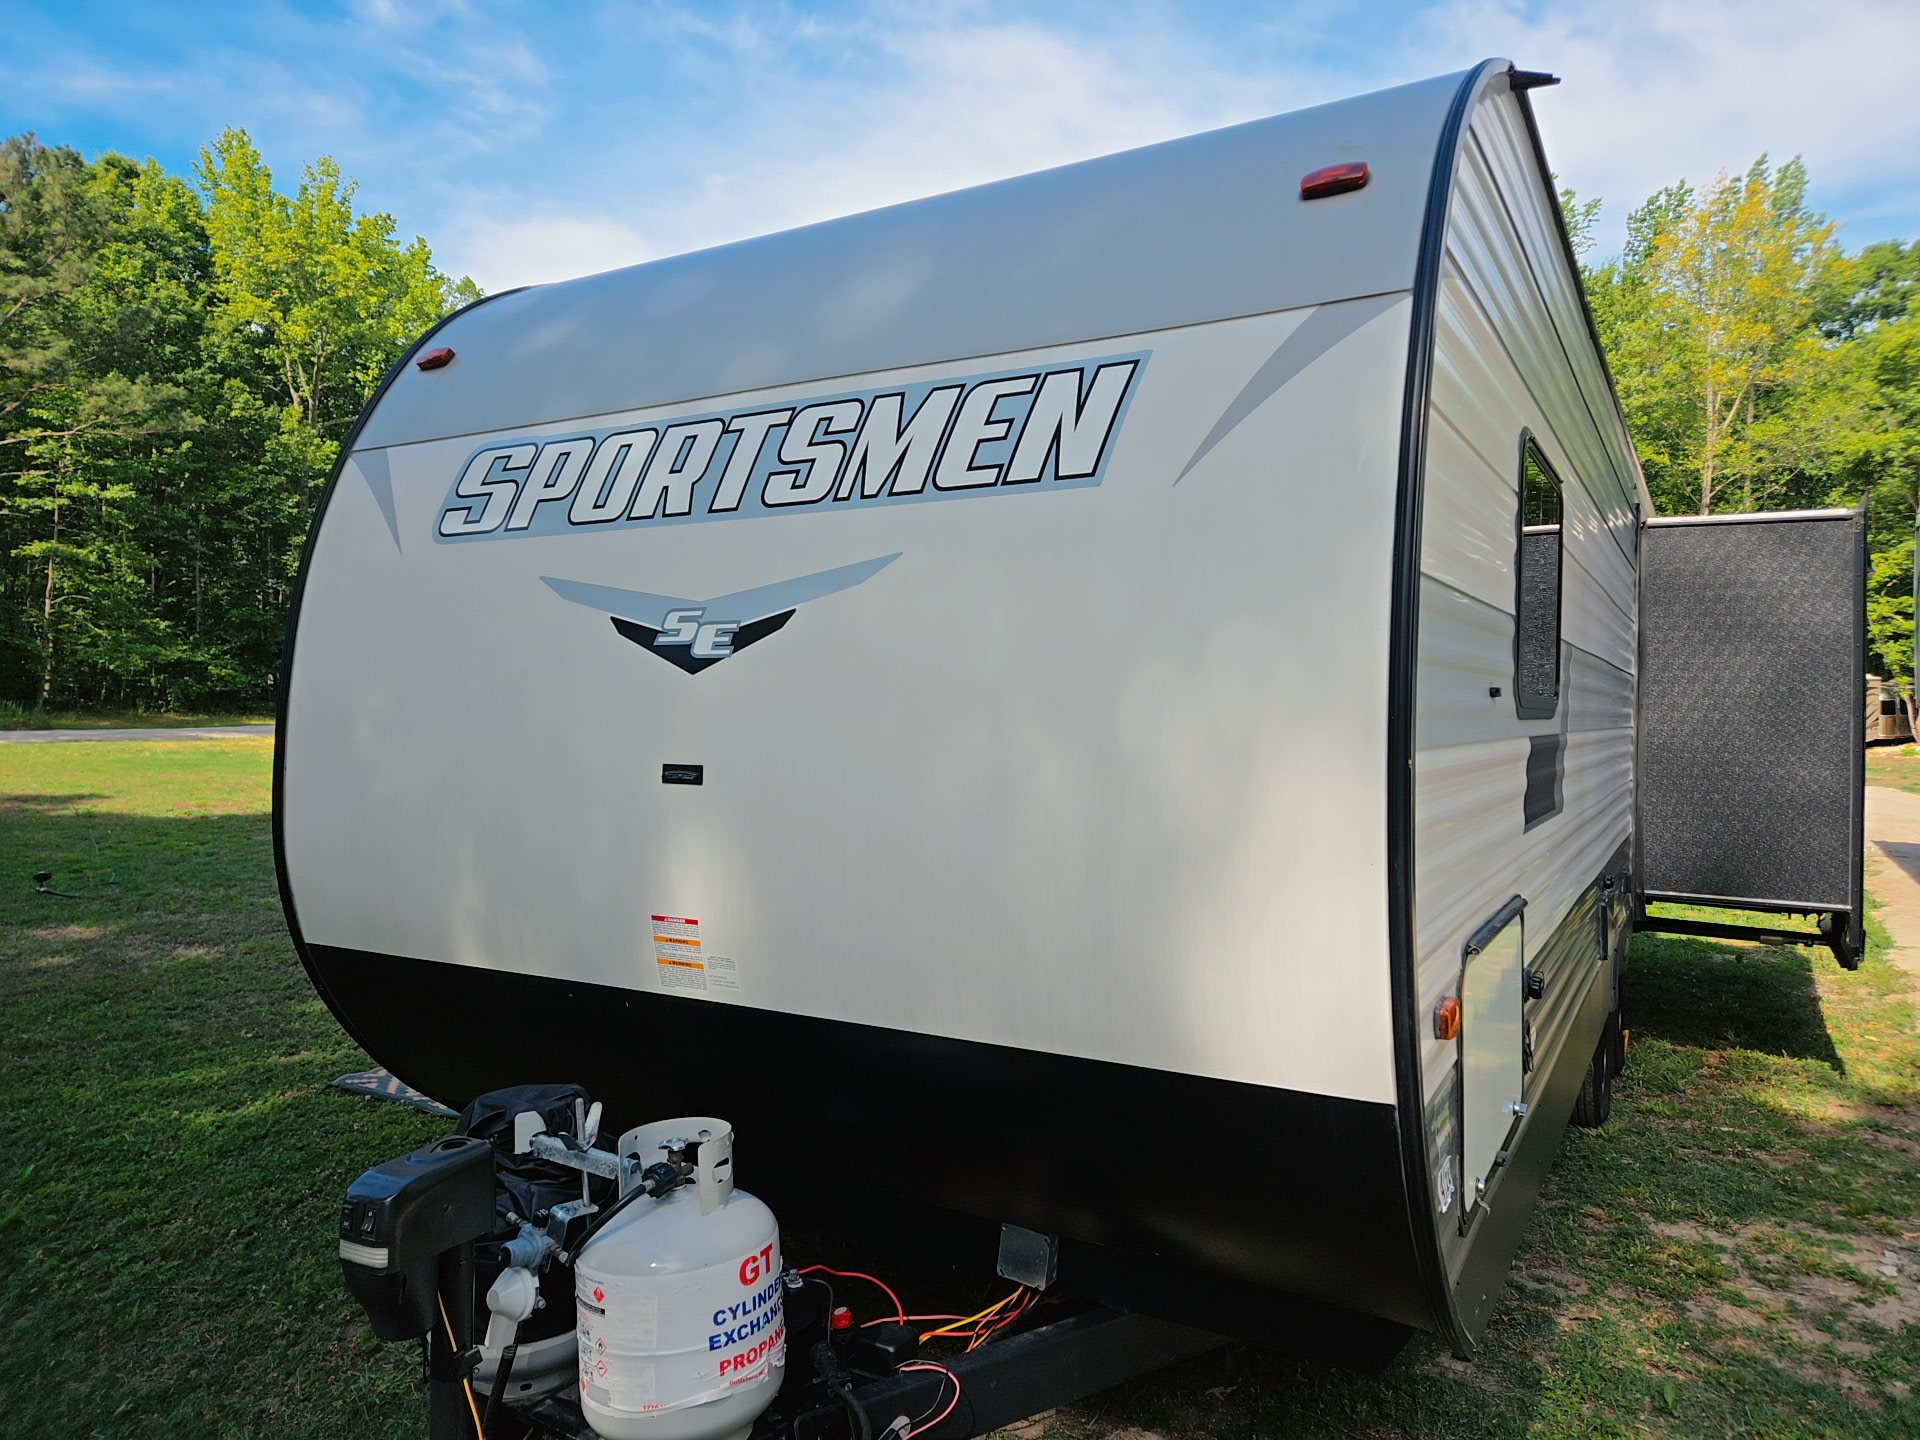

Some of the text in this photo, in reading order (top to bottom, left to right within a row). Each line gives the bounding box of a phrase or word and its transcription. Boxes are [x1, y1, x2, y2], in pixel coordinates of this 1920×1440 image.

[438, 359, 1141, 537] SPORTSMEN
[654, 607, 740, 658] SE
[739, 1243, 773, 1287] GT
[708, 1291, 783, 1352] EXCHANG
[712, 1276, 782, 1327] CYLINDE
